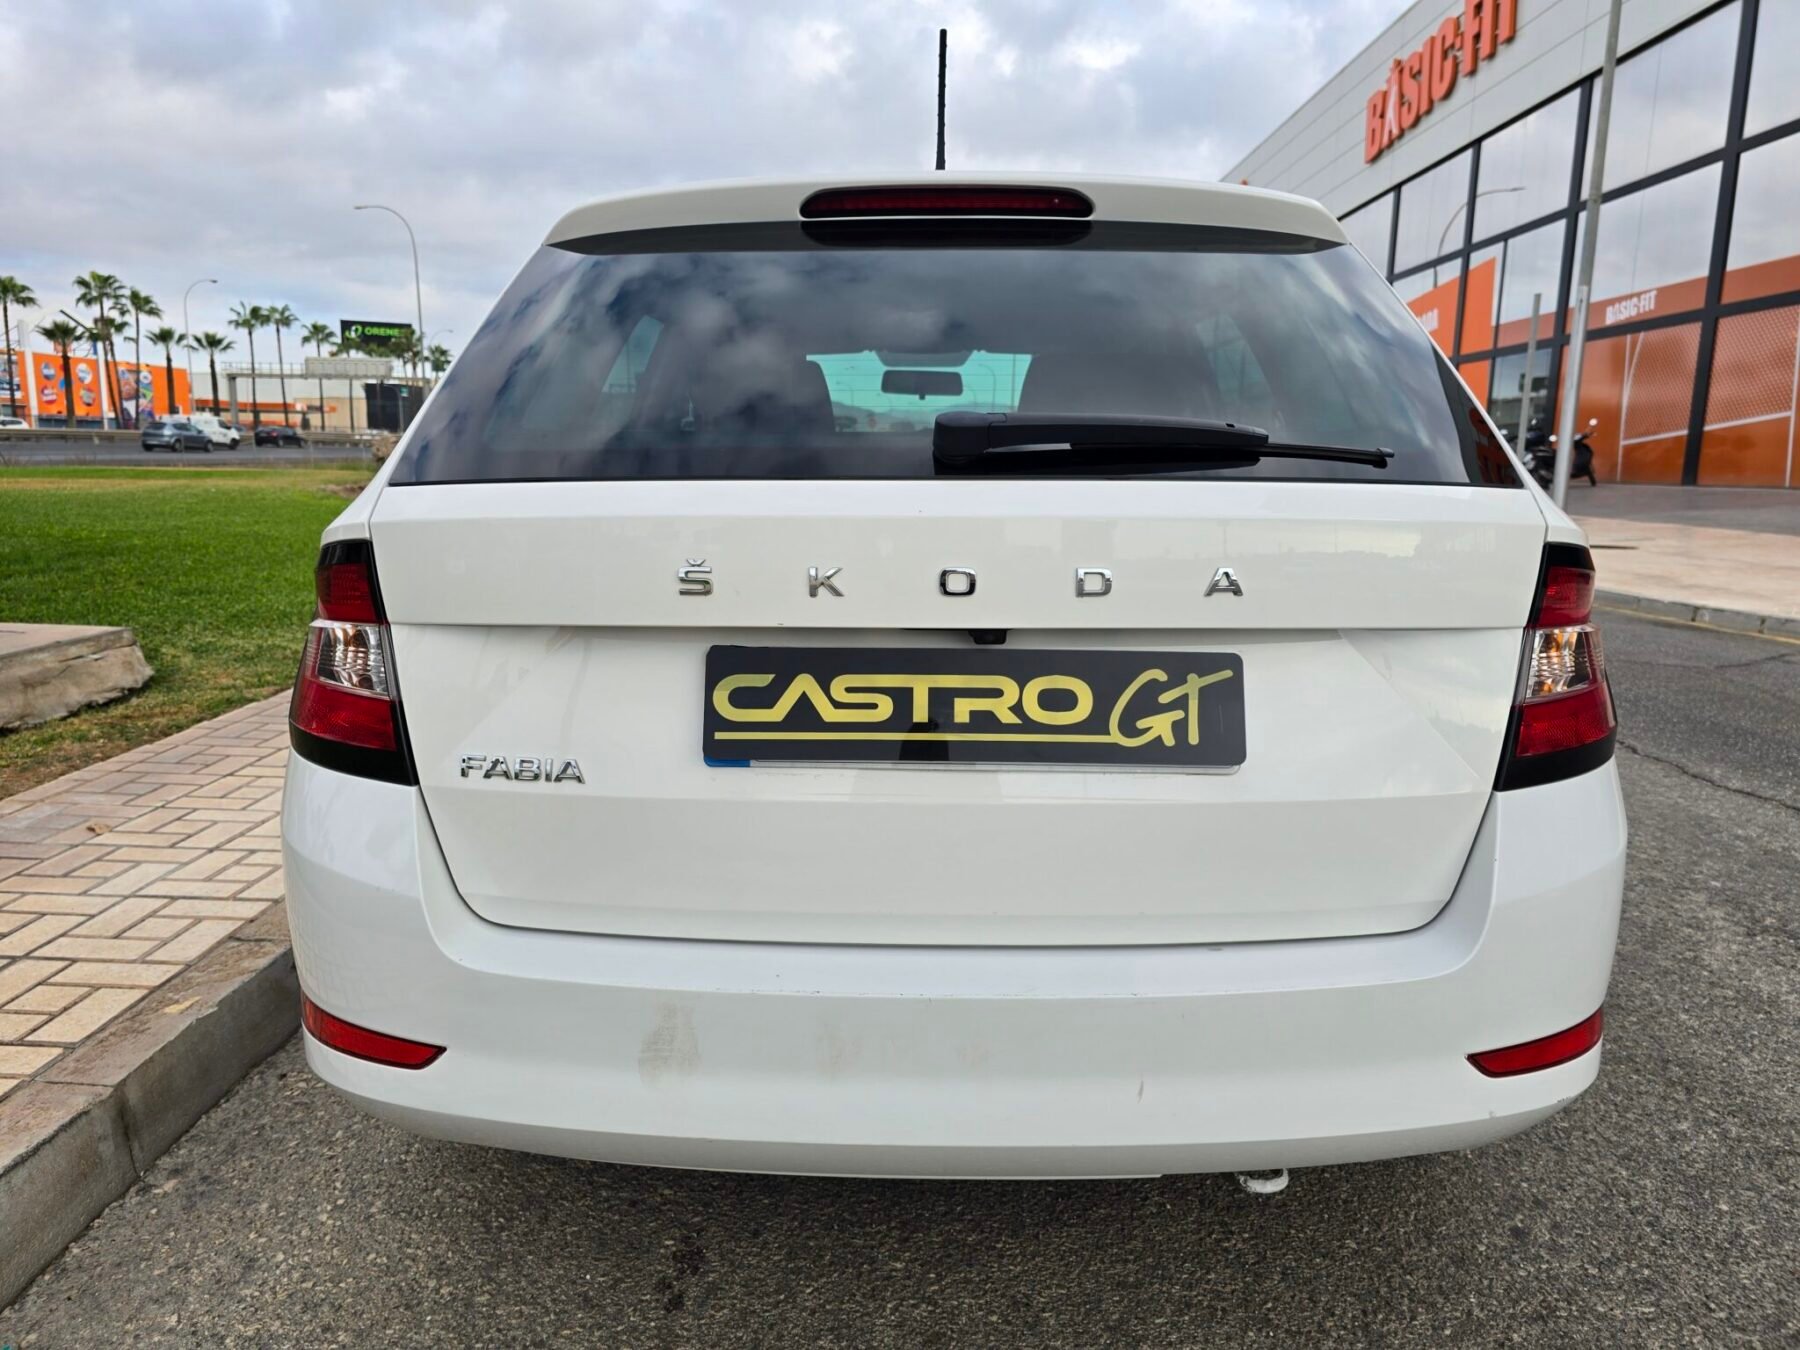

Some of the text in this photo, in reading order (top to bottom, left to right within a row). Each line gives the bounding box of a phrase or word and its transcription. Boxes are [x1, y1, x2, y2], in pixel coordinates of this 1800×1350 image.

[677, 558, 1244, 597] ŠKODA
[712, 668, 1233, 747] CASTRO GT
[460, 754, 586, 784] FABIA
